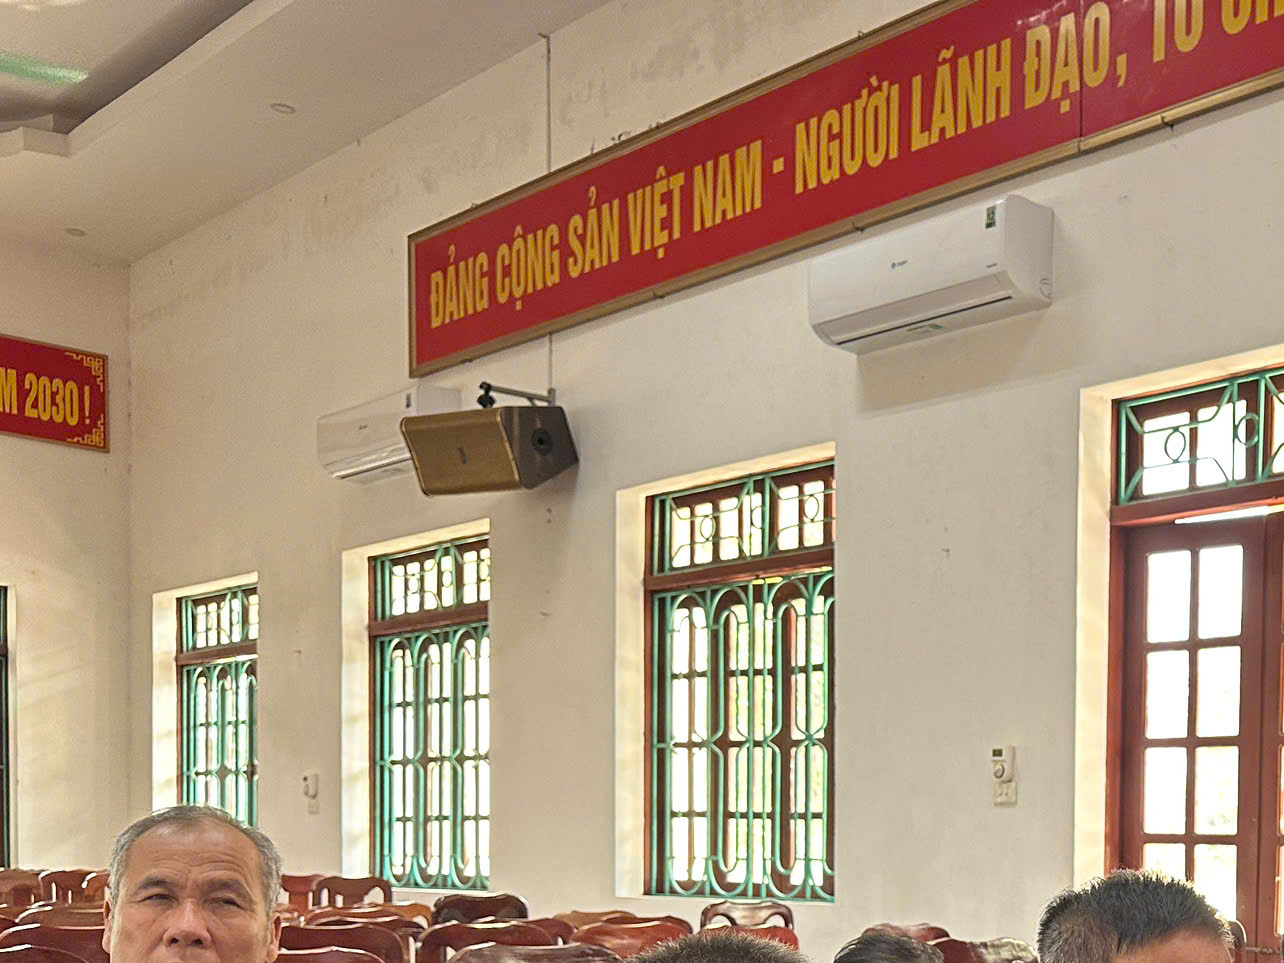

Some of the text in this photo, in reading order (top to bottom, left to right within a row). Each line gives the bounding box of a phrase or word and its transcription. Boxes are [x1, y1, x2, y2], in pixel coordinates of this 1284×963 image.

[430, 244, 489, 329] ĐẢNG
[496, 224, 560, 311] CỘNG
[567, 186, 620, 279] SẢN
[627, 167, 685, 259] VIỆT
[693, 139, 762, 233] NAM
[795, 75, 900, 194] NGƯỜI
[911, 47, 1012, 151] LÃNH
[1023, 3, 1128, 113] ĐẠO,
